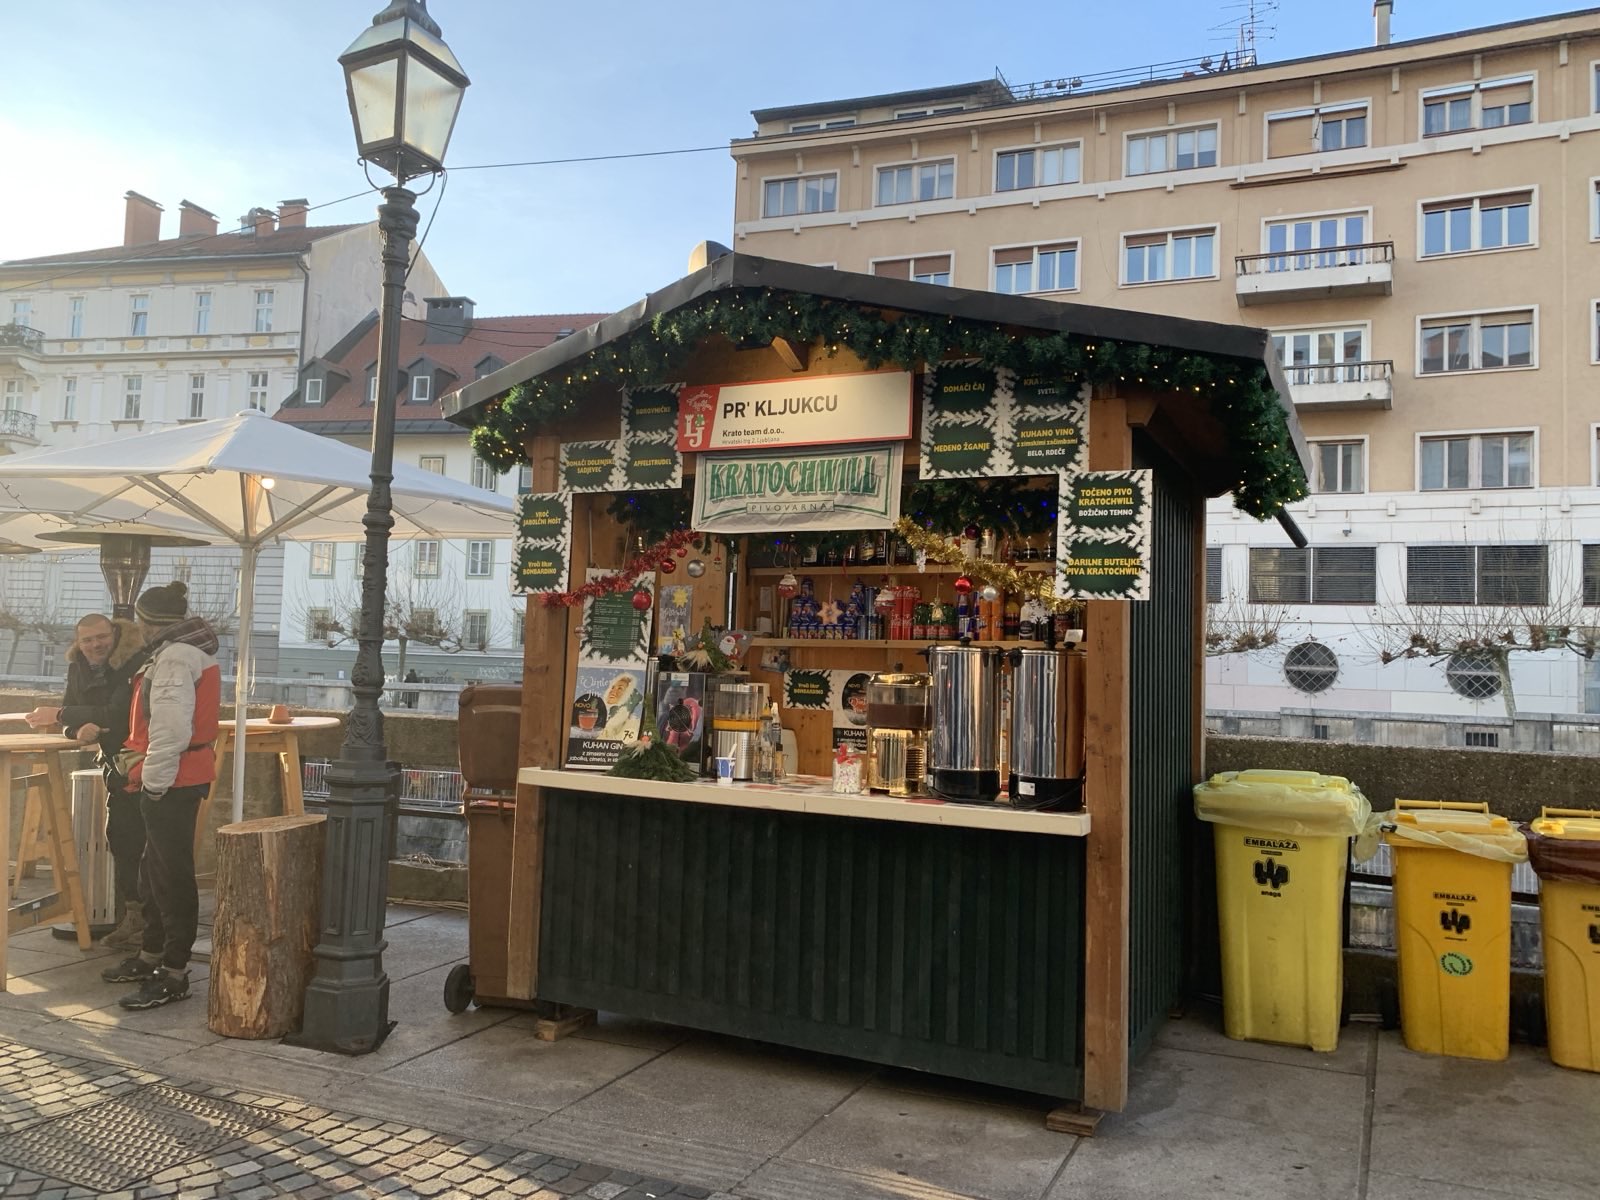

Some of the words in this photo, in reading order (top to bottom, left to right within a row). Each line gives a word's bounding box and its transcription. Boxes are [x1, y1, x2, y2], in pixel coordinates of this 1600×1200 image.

[943, 384, 972, 393] DOMAČI
[973, 382, 985, 391] ČAJ
[723, 402, 750, 419] PR'
[755, 395, 838, 417] KLJUKCU
[1020, 430, 1053, 438] KUHANO
[1055, 428, 1074, 436] VINO
[934, 444, 961, 452] MEDENO
[963, 442, 990, 451] ŽGANJE
[1046, 448, 1066, 456] RDEČE
[710, 456, 880, 500] KRATOCHWILL
[1081, 488, 1112, 497] TOČENO
[1114, 488, 1132, 496] PIVO
[1078, 497, 1134, 506] KRATOCHWILL
[751, 502, 828, 512] PIVOVARNA
[1078, 508, 1108, 516] BOŽIČNO
[1104, 559, 1141, 567] BUTELJKE
[582, 741, 609, 749] KUHAN
[610, 742, 624, 750] GIN
[1245, 838, 1298, 849] EMBALAŽA
[1434, 892, 1477, 901] EMBALAŽA
